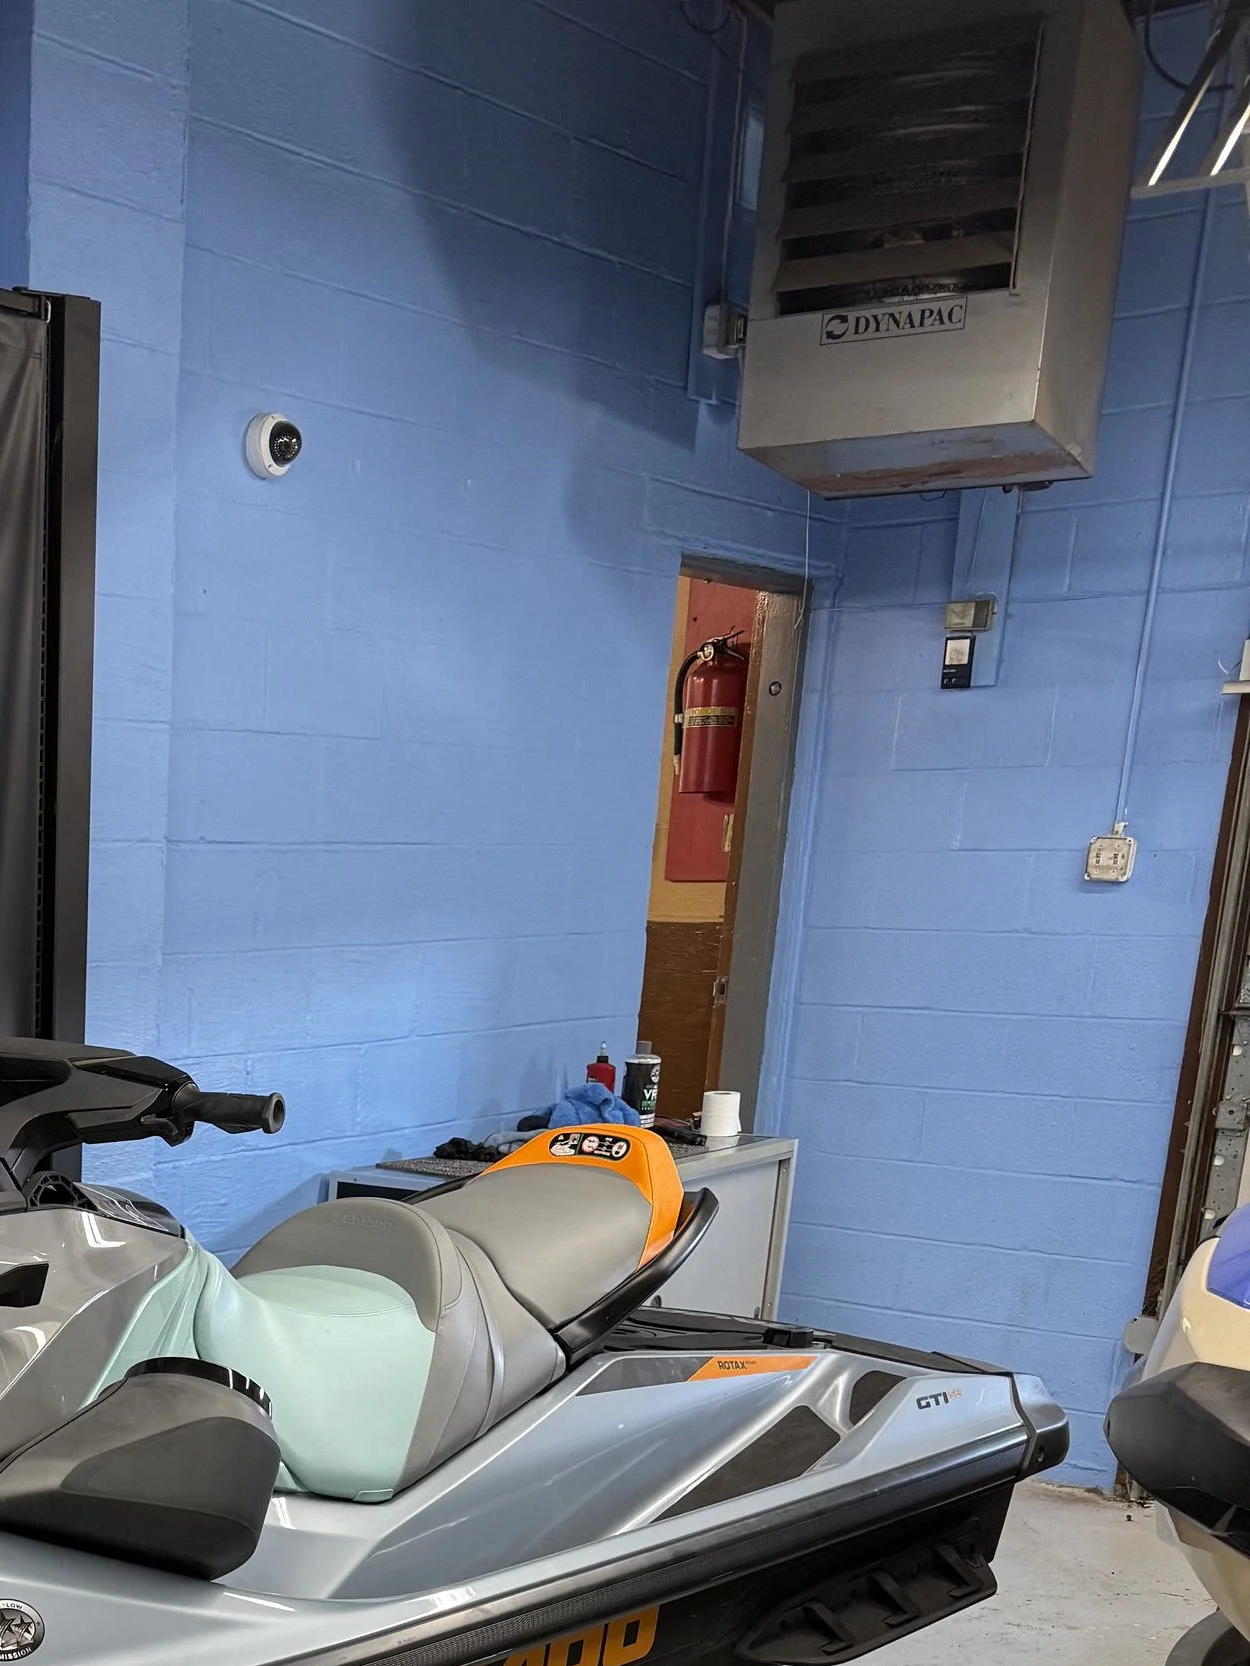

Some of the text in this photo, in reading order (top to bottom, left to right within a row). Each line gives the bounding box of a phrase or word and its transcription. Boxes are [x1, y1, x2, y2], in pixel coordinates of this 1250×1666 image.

[853, 304, 963, 335] DYNAPAC
[717, 1360, 747, 1370] ROTAX
[916, 1391, 950, 1410] GTI
[5, 1602, 23, 1610] LOW
